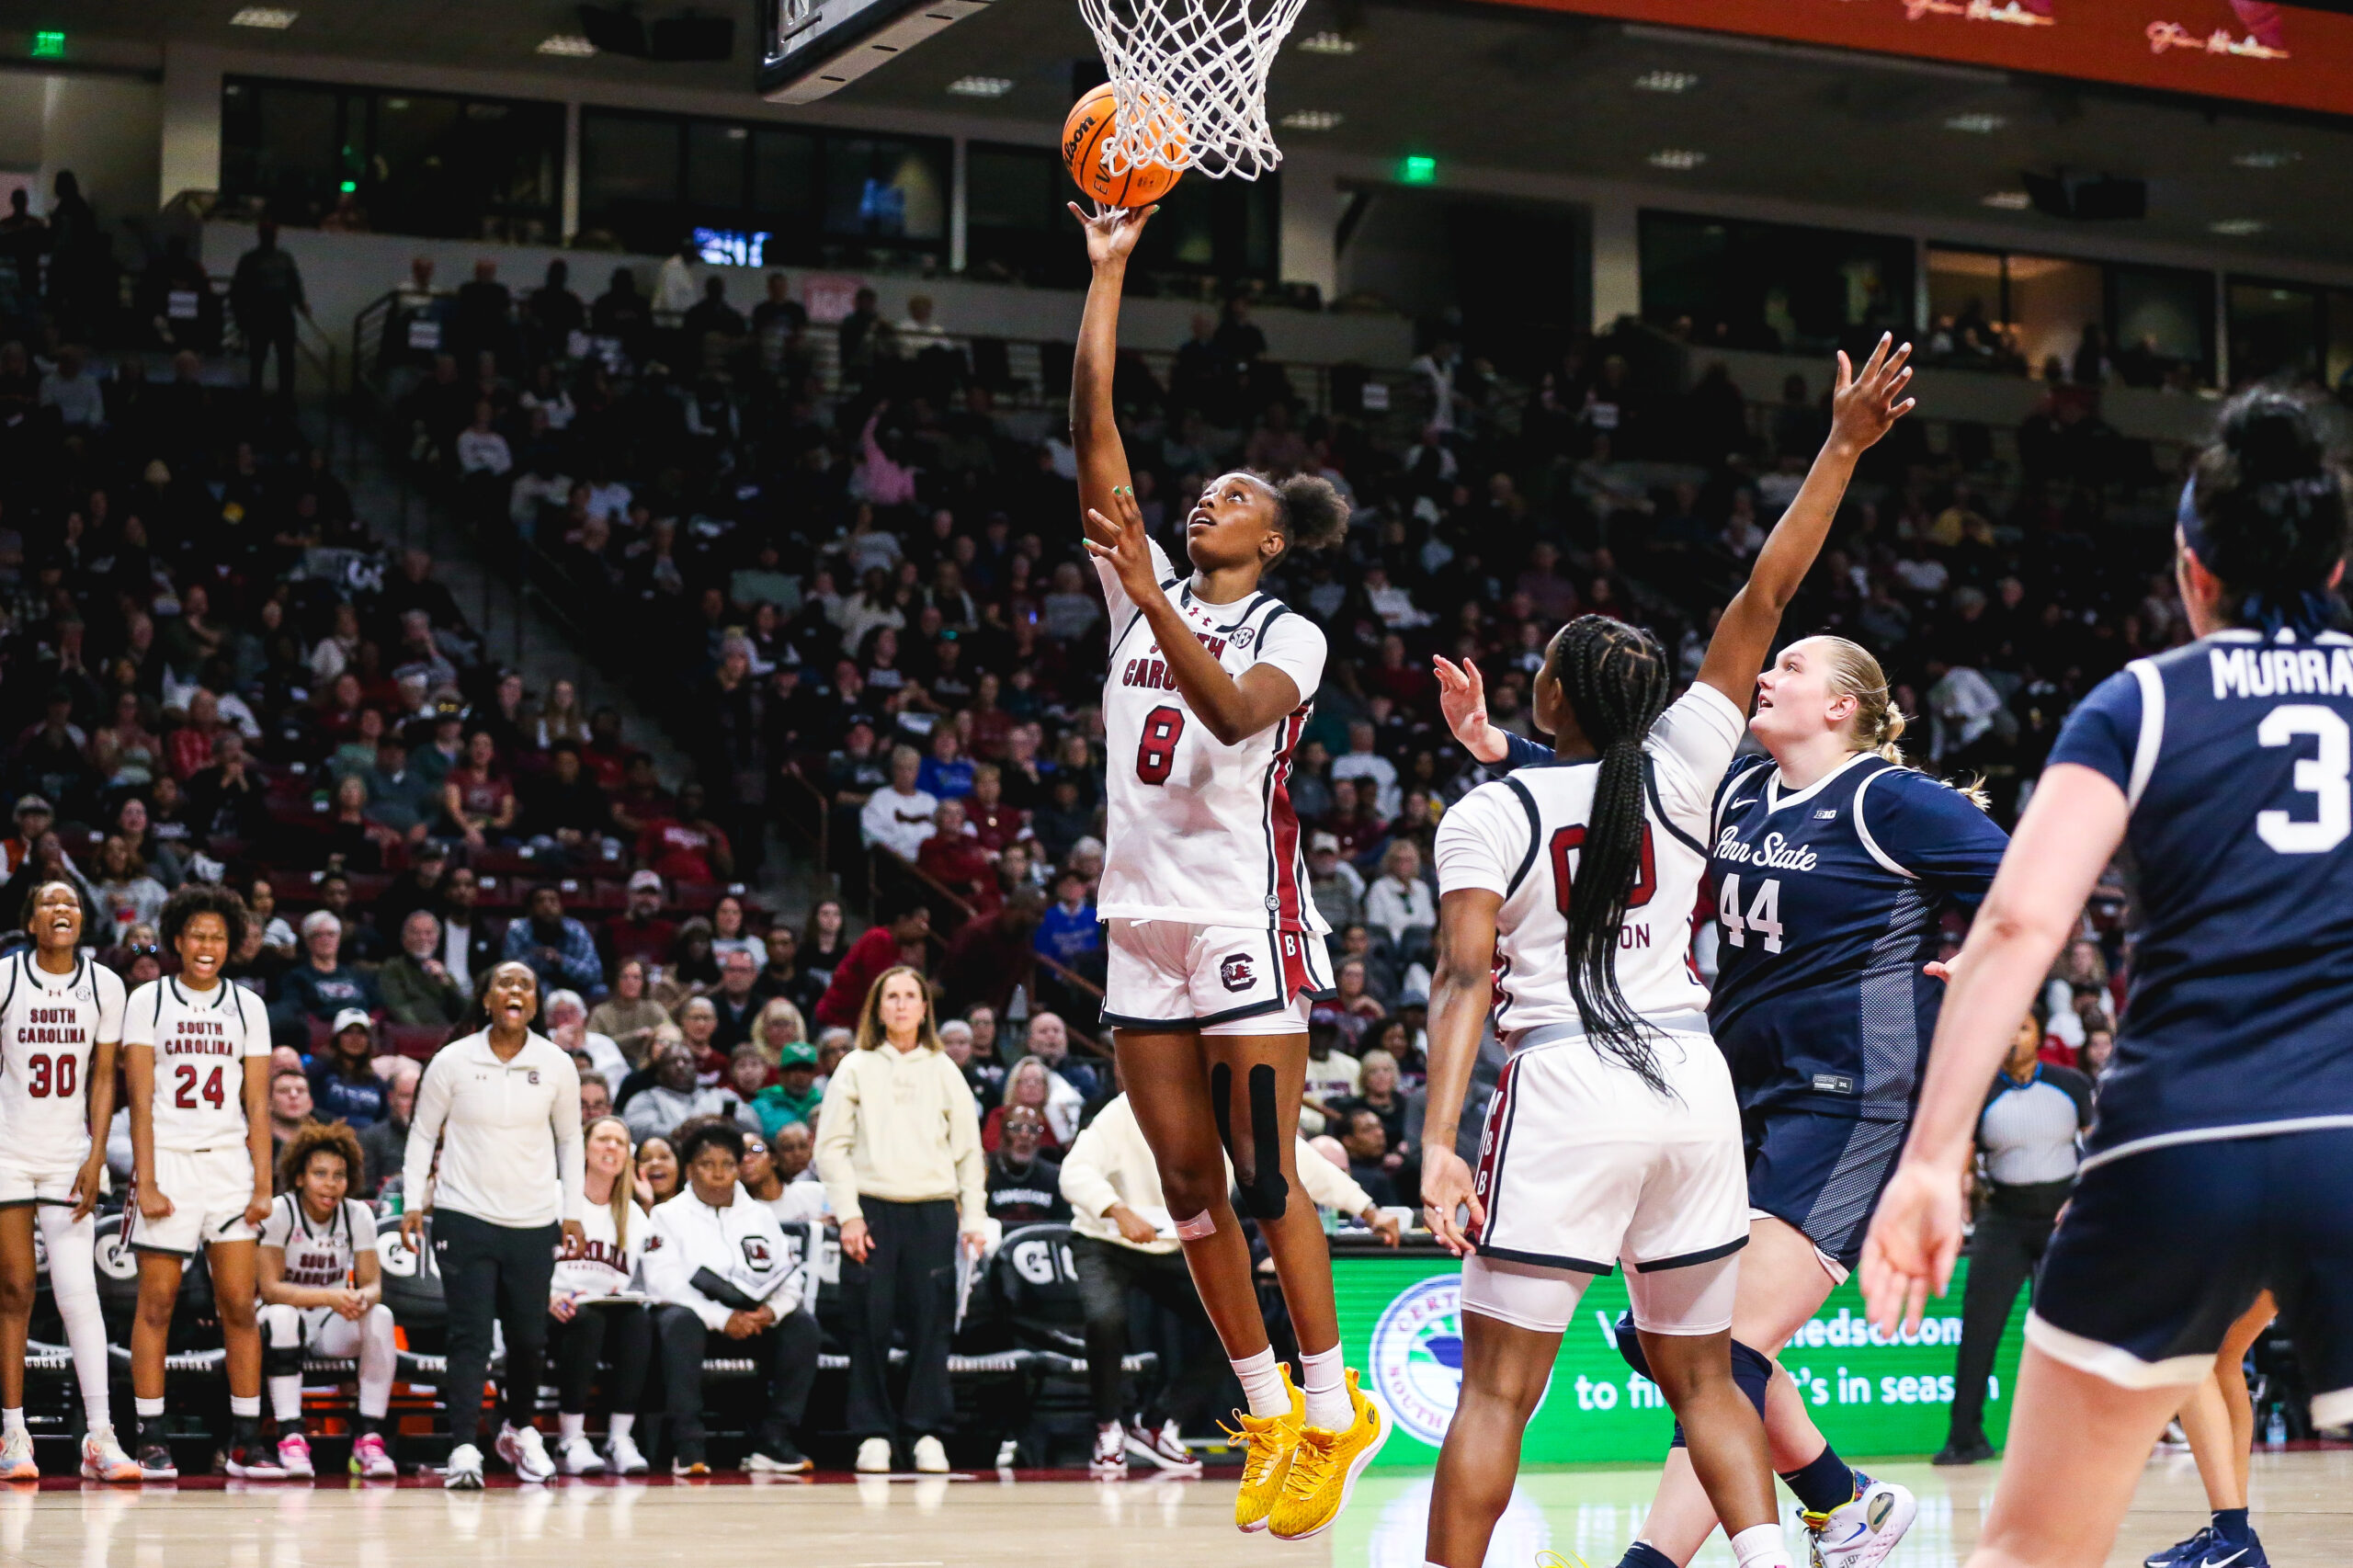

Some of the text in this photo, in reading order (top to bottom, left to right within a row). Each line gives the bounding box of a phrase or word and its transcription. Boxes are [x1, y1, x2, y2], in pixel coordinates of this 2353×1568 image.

[1063, 116, 1097, 168] ilson
[1231, 629, 1254, 646] SEC
[2210, 647, 2353, 700] MURRA
[1136, 705, 1186, 786] 8
[2256, 703, 2351, 854] 3
[1713, 824, 1817, 871] Penn State
[1720, 873, 1783, 954] 44
[17, 1028, 85, 1044] CAROLINA
[30, 1008, 75, 1023] SOUTH
[177, 1021, 223, 1036] SOUTH
[165, 1040, 233, 1056] CAROLINA
[28, 1053, 76, 1097] 30
[175, 1065, 224, 1110] 24
[1389, 1366, 1443, 1428] SOUTH
[1574, 1374, 1618, 1410] to
[1626, 1370, 1665, 1409] fi
[1837, 1367, 1871, 1403] in
[1880, 1375, 1999, 1404] seas
